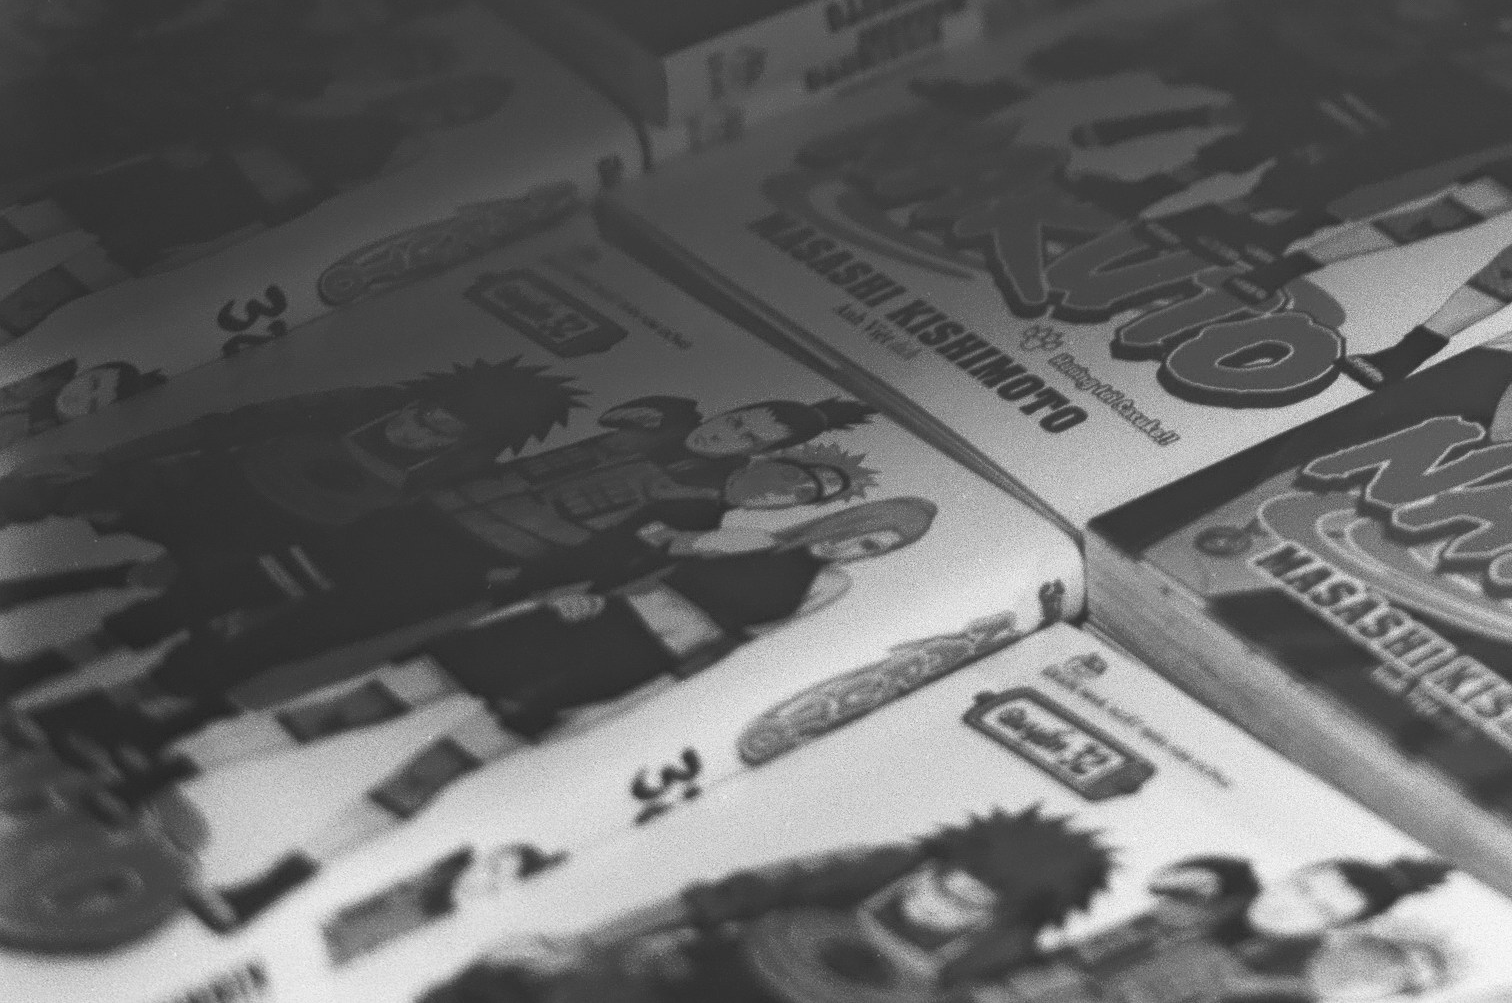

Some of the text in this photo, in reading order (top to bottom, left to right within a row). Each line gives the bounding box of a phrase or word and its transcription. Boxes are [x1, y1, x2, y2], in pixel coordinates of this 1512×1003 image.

[748, 211, 906, 309] MASASHI
[885, 298, 1089, 434] KISHIMOTO
[1248, 541, 1458, 678] MASASHI
